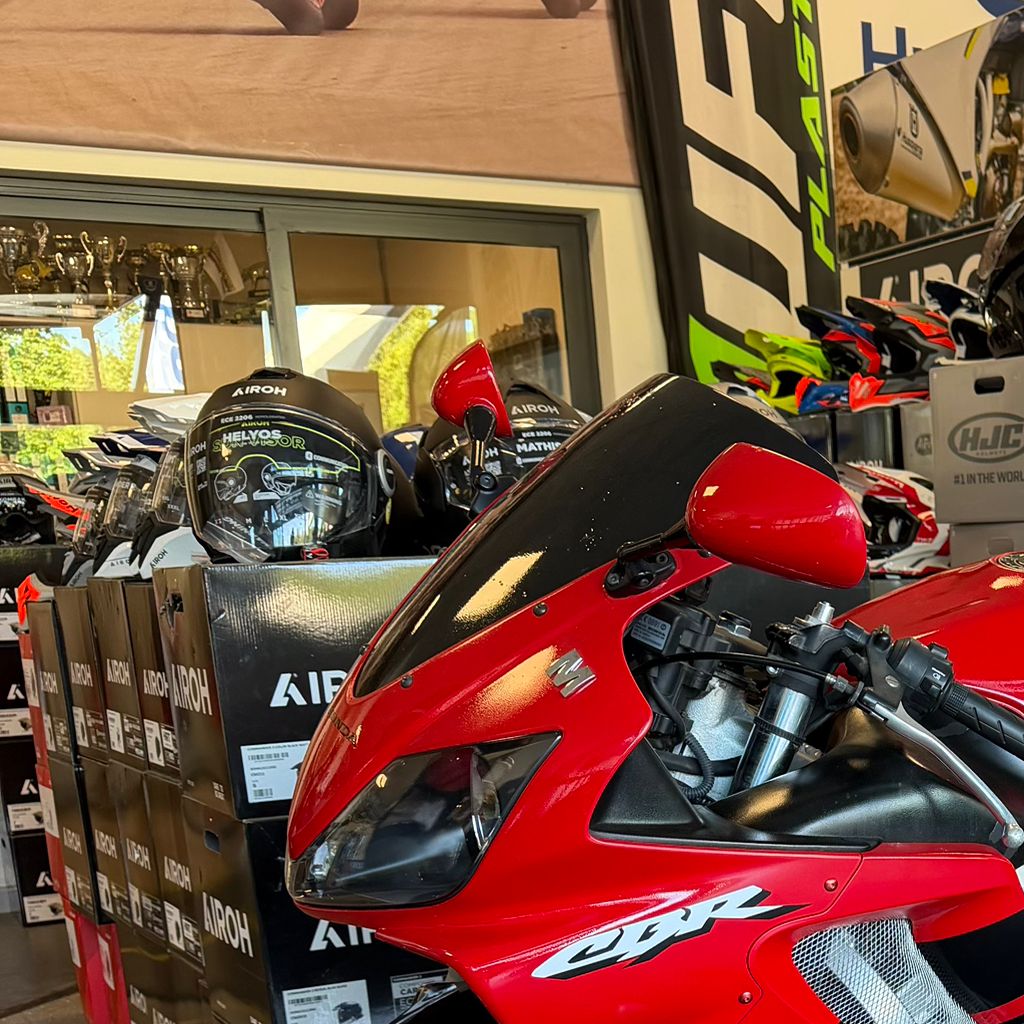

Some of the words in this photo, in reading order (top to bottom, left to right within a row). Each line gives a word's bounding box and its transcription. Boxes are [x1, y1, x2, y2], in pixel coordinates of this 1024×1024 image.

[232, 385, 288, 398] AIROH
[511, 403, 560, 416] AIROH
[222, 429, 283, 444] HELYOS
[960, 423, 1024, 451] HJC
[953, 474, 965, 485] #1
[966, 473, 976, 485] IN
[976, 471, 995, 484] THE
[70, 661, 94, 688] AIROH
[106, 658, 131, 688] AIROH
[171, 663, 214, 717] AIROH
[63, 826, 83, 856] AIROH
[95, 829, 118, 860] AIROH
[126, 838, 151, 872] AIROH
[164, 855, 193, 893] AIROH
[202, 891, 255, 959] AIROH
[531, 884, 802, 979] CBR
